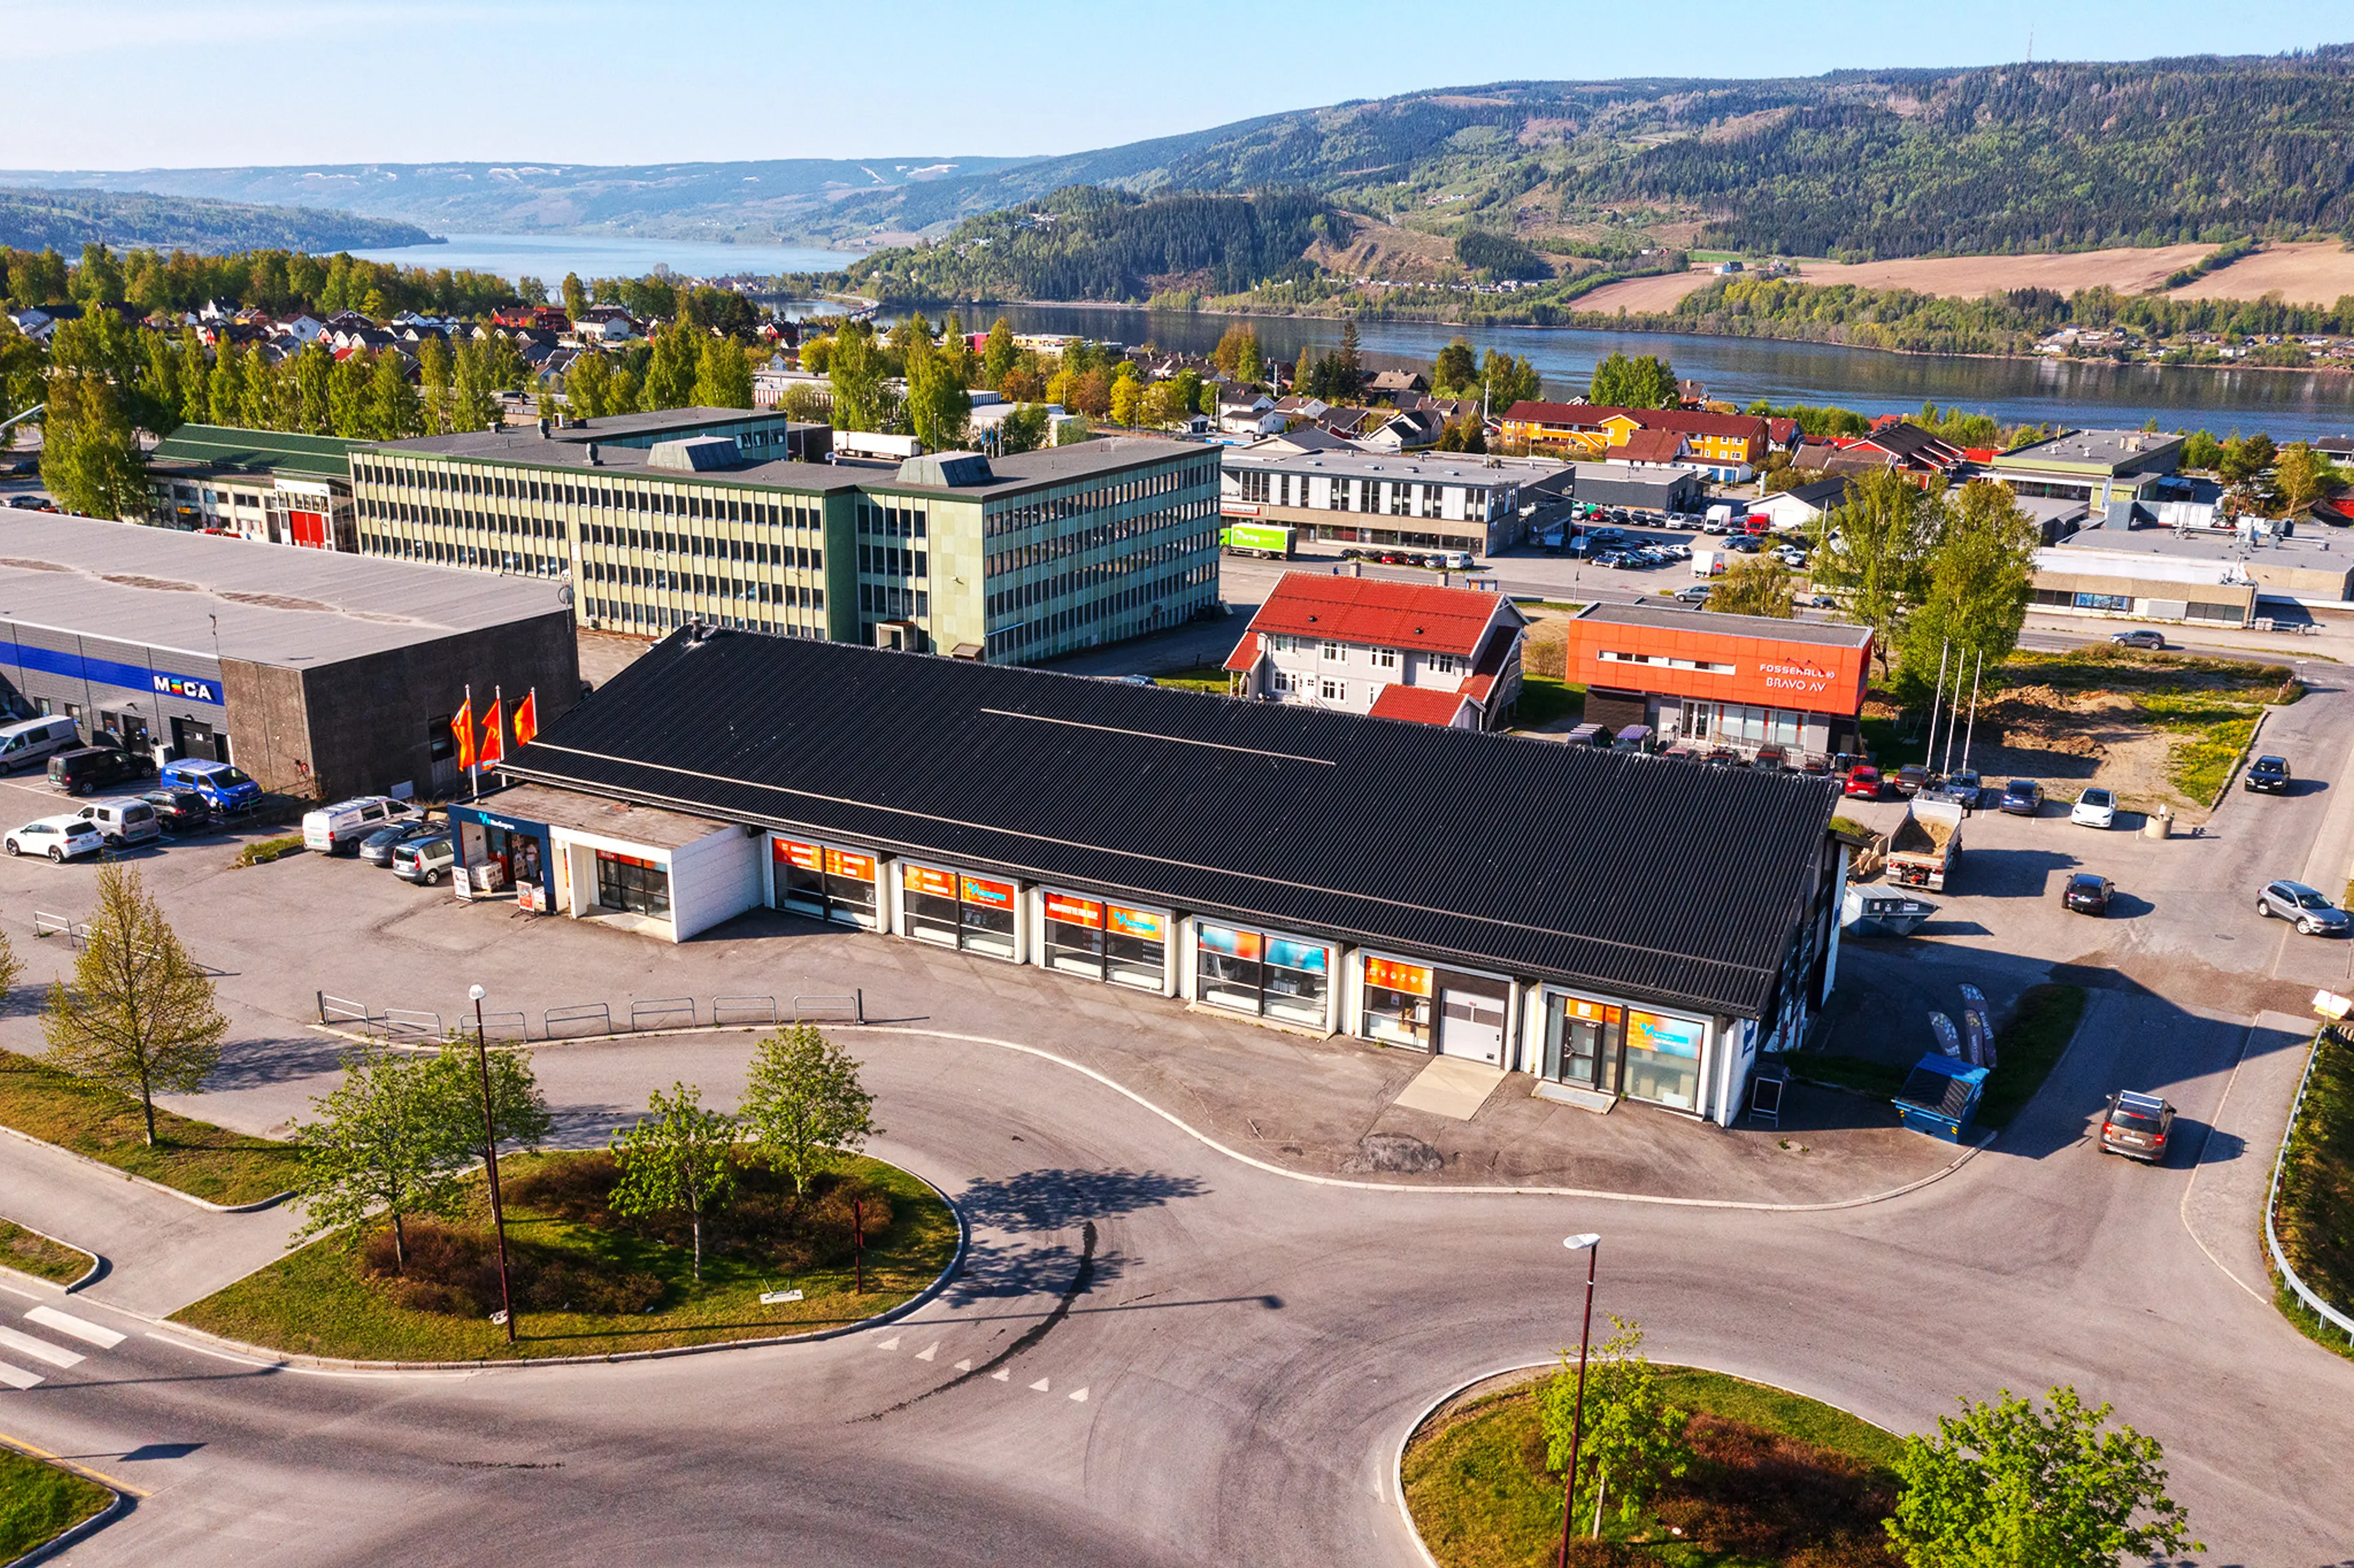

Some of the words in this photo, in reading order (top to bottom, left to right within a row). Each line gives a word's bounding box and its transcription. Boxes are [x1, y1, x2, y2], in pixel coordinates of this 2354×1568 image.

[1241, 533, 1259, 542] bring
[1759, 664, 1825, 678] FOSSEKALL
[153, 676, 212, 700] MECA
[1766, 677, 1807, 690] BRAVO
[1809, 682, 1826, 692] AV
